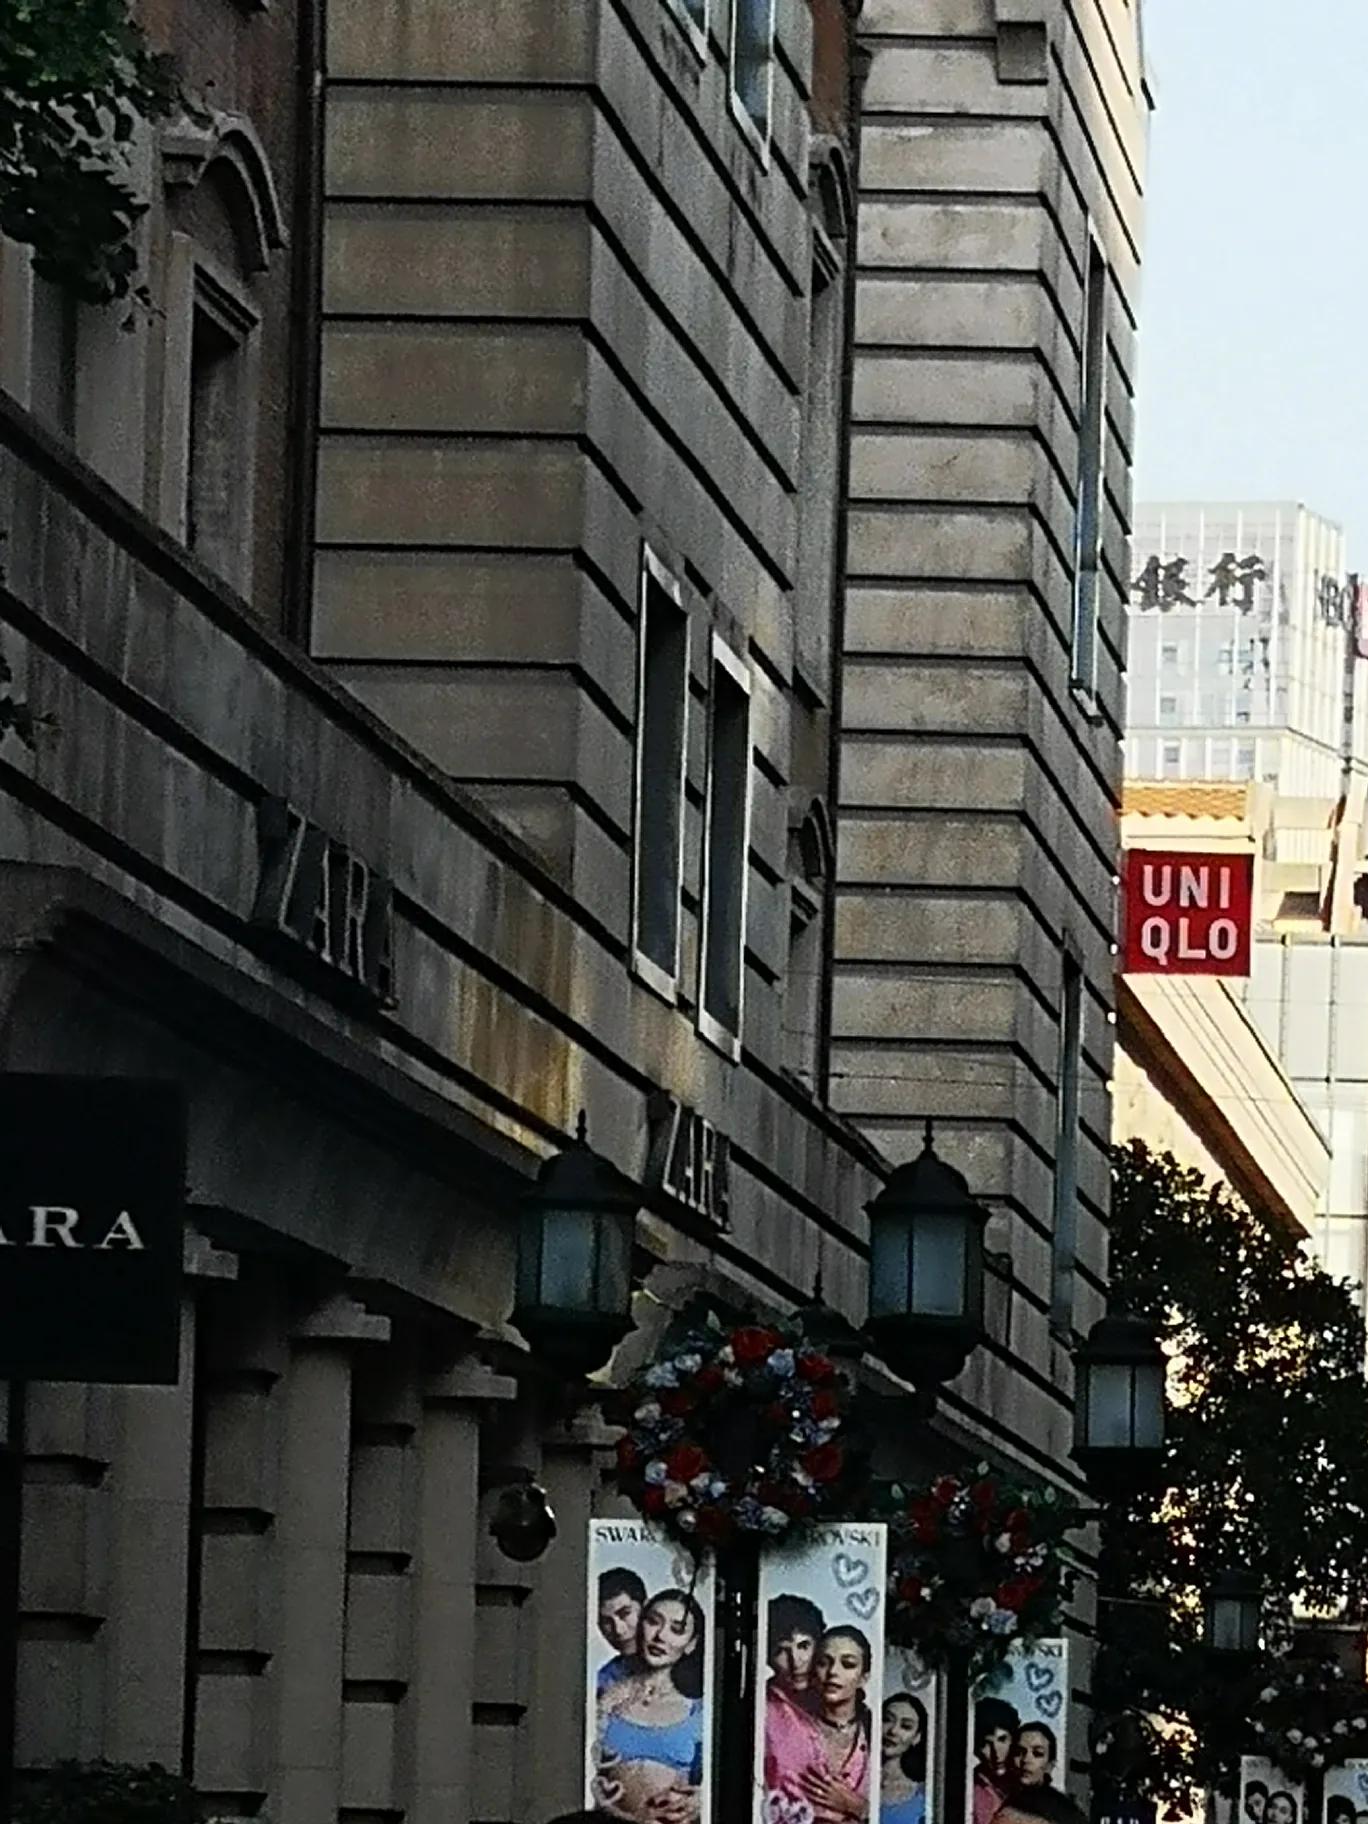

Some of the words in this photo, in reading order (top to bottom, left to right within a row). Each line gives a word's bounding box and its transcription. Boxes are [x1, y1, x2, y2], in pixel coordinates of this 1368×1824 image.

[1143, 864, 1231, 909] UNI
[1141, 916, 1238, 966] QLO
[0, 1205, 145, 1250] RA
